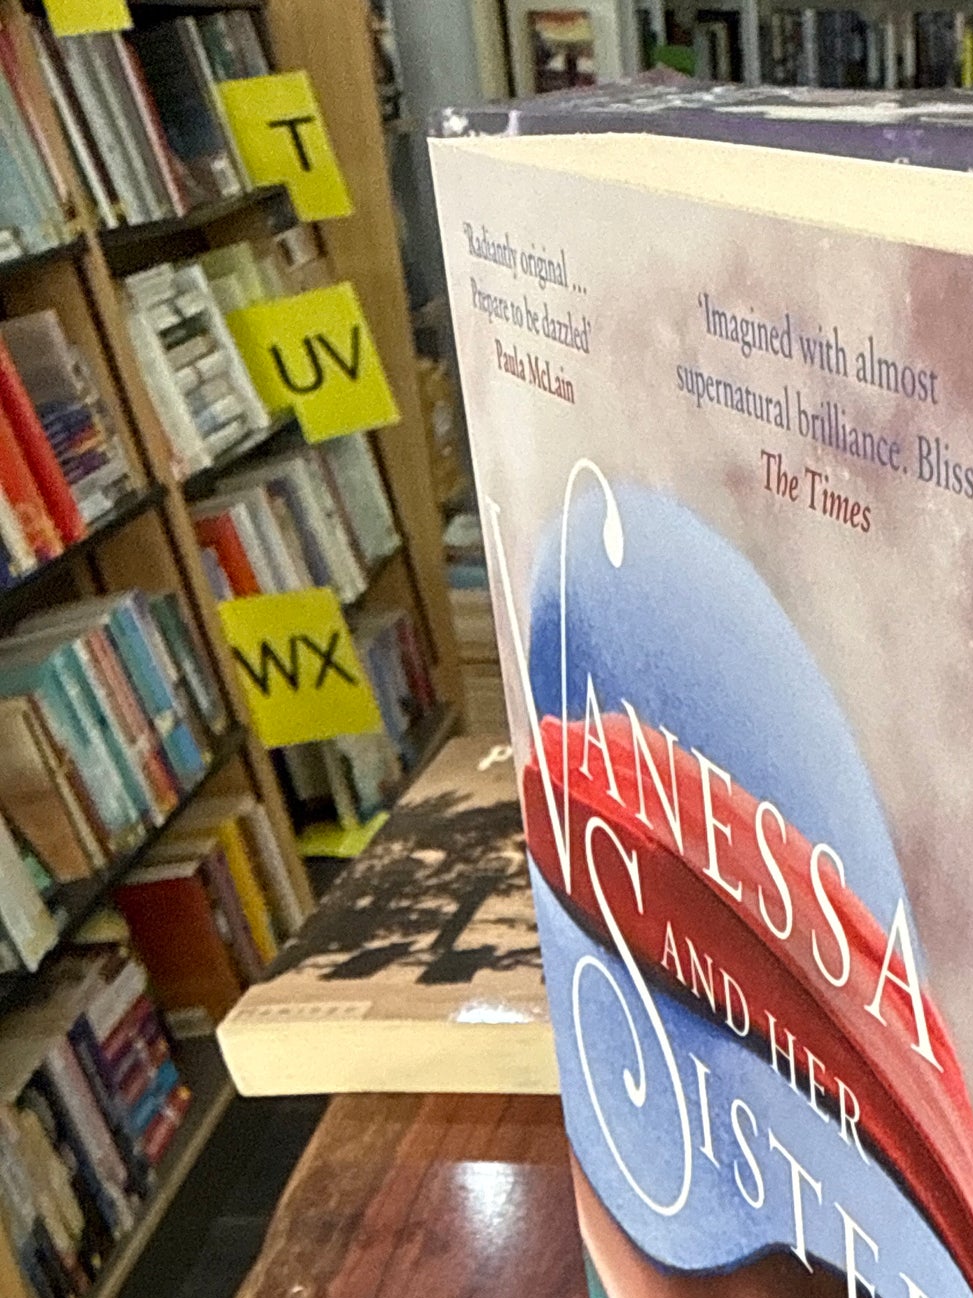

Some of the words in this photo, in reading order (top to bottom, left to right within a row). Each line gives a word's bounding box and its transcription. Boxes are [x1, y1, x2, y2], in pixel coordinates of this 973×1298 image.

[267, 115, 315, 172] T
[521, 243, 568, 290] original
[470, 277, 510, 323] Prepare
[511, 300, 524, 328] to
[524, 295, 540, 335] be
[269, 324, 360, 394] UV
[495, 338, 526, 381] Paula
[527, 353, 575, 404] McLain
[799, 325, 848, 378] with
[856, 336, 938, 404] almost
[676, 364, 791, 431] supernatural
[796, 391, 908, 475] brilliance.
[761, 449, 799, 502] The
[805, 466, 871, 533] Times
[232, 631, 358, 698] WX
[485, 458, 945, 1073] VANESSA
[660, 921, 750, 1038] AND
[764, 1010, 872, 1166] HER
